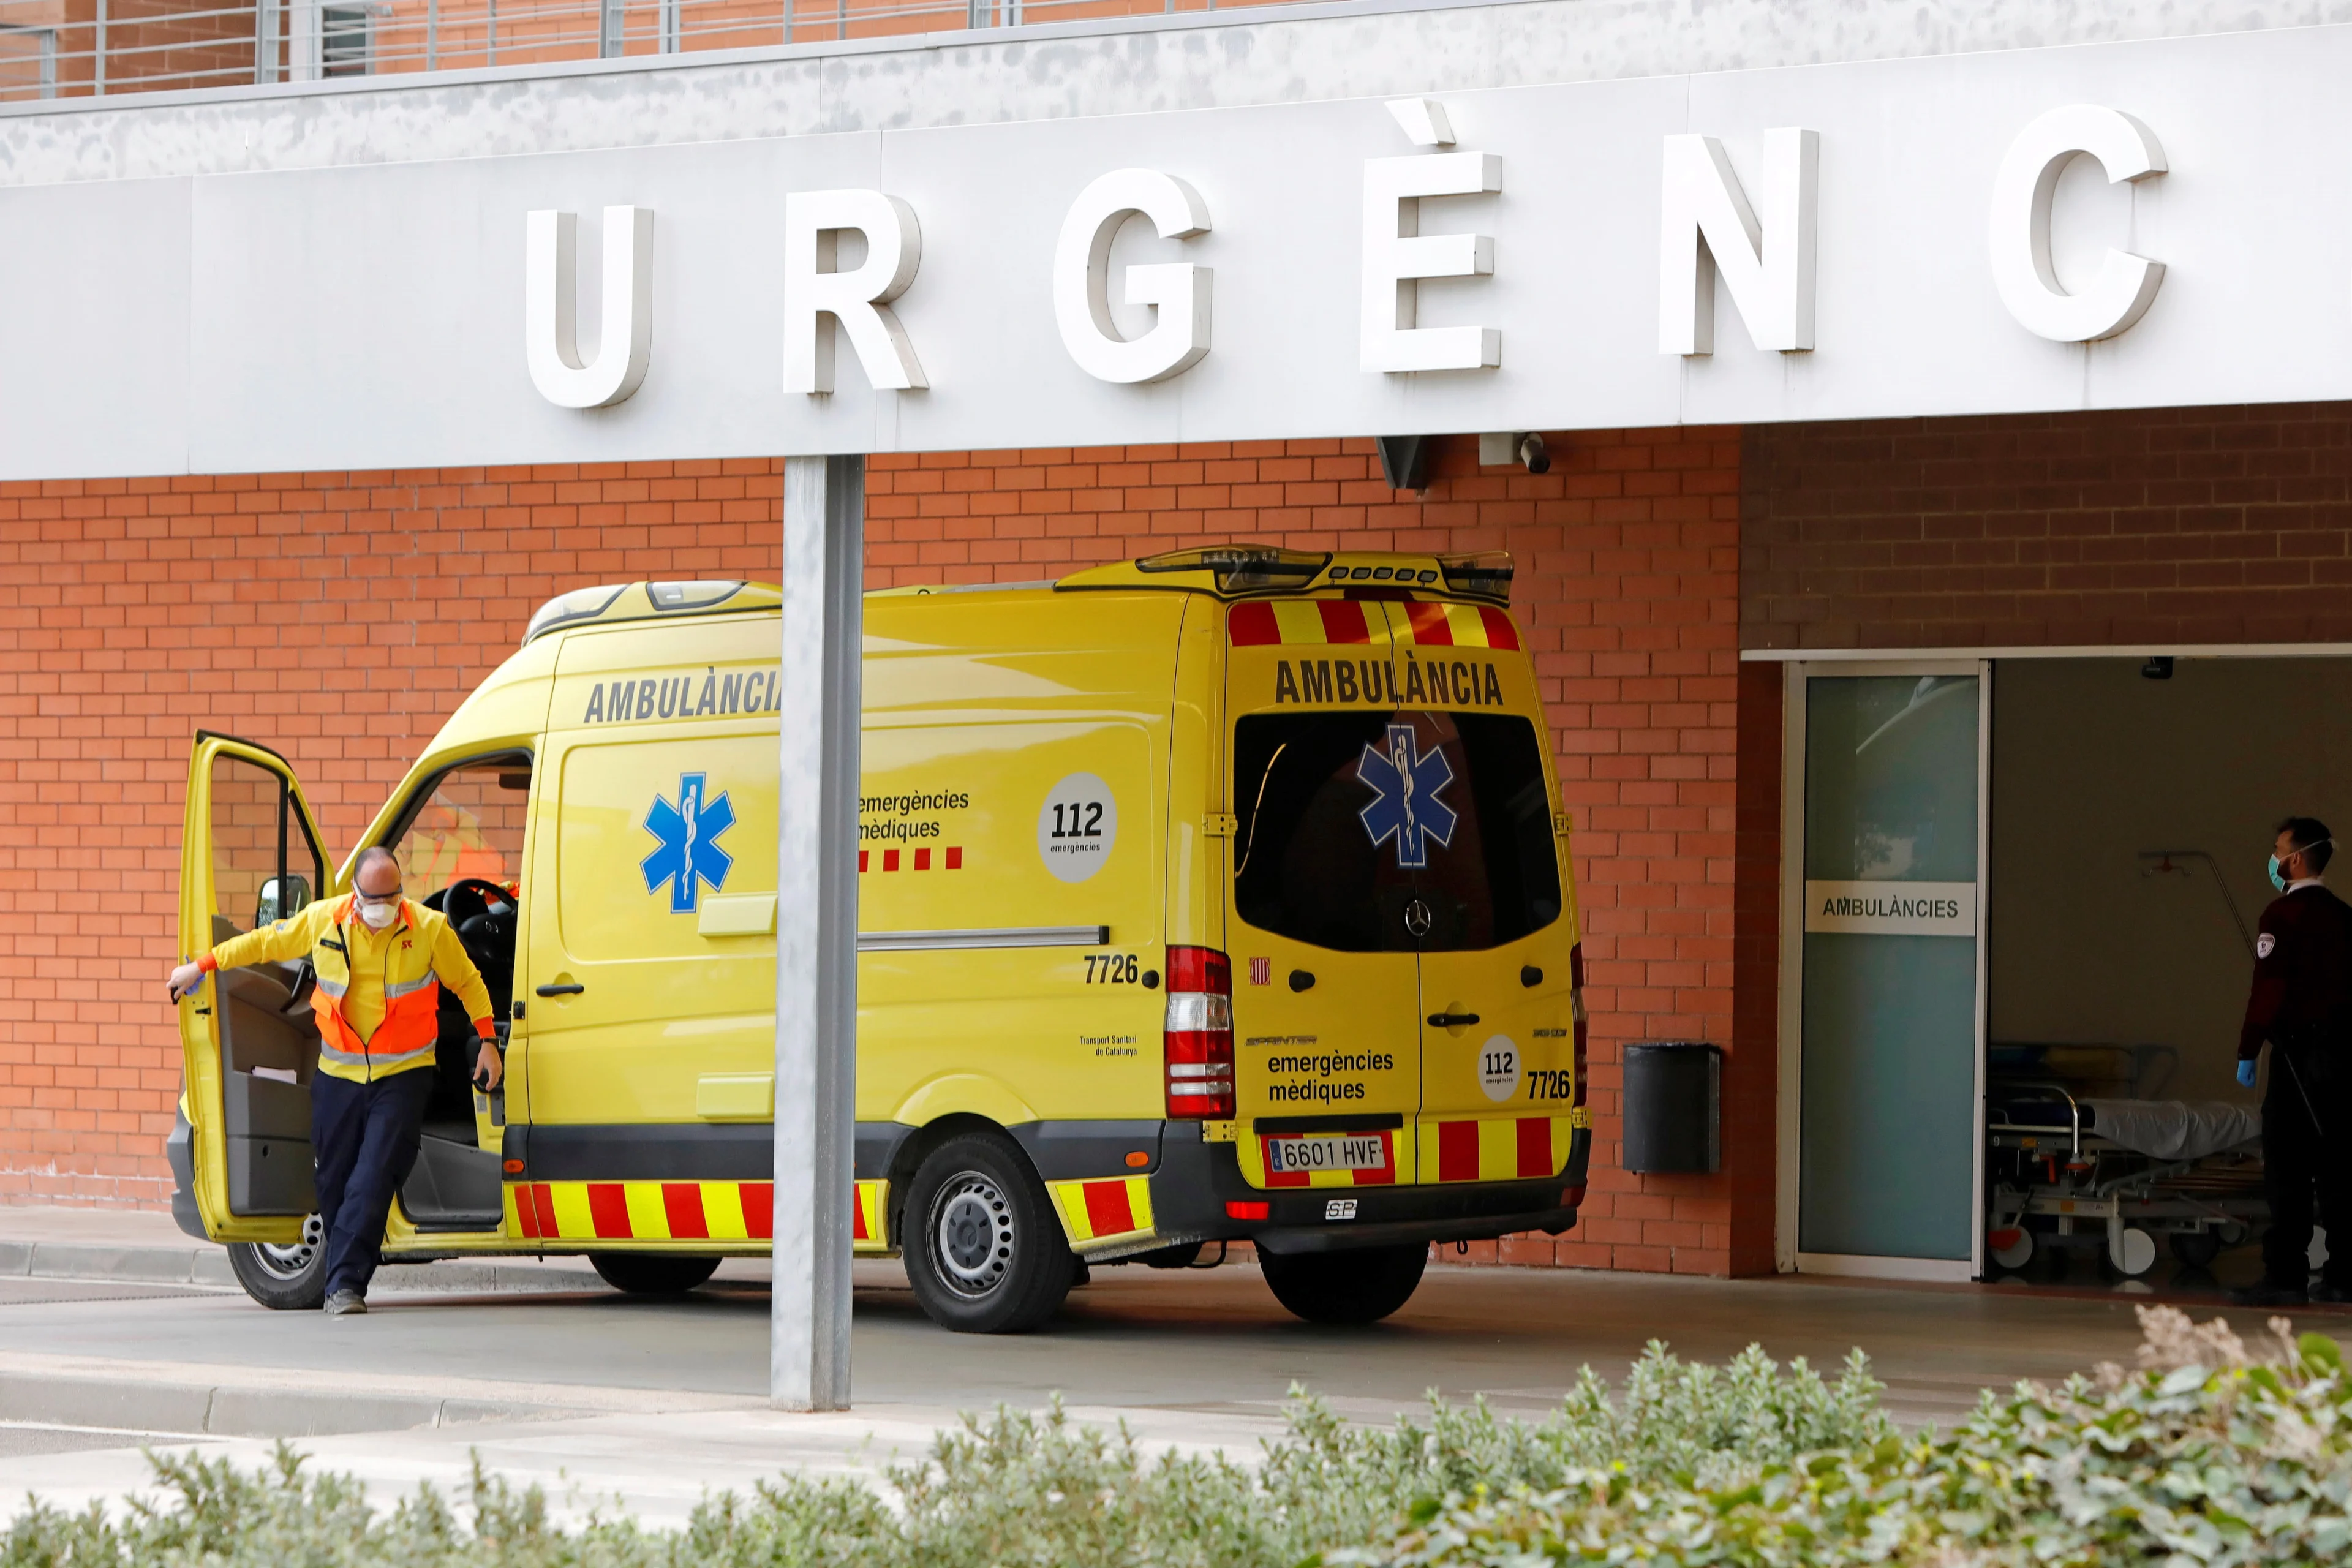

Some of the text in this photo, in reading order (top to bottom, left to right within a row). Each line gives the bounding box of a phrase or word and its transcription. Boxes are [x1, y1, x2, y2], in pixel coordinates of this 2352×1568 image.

[526, 99, 2168, 409] URGÈNC
[1275, 650, 1504, 706] AMBULÀNCIA
[1051, 802, 1103, 838] 112
[1050, 842, 1101, 854] emergències
[1822, 895, 1958, 918] AMBULÀNCIES
[1084, 954, 1138, 983] 7726
[1080, 1035, 1137, 1046] Transport Sanitari
[1096, 1047, 1137, 1057] de Catalunya
[1268, 1050, 1393, 1076] emergències
[1485, 1052, 1513, 1074] 112
[1268, 1079, 1365, 1104] mèdiques
[1528, 1070, 1570, 1099] 7726
[1284, 1140, 1378, 1166] 6601 HVF
[1329, 1202, 1355, 1218] SP
